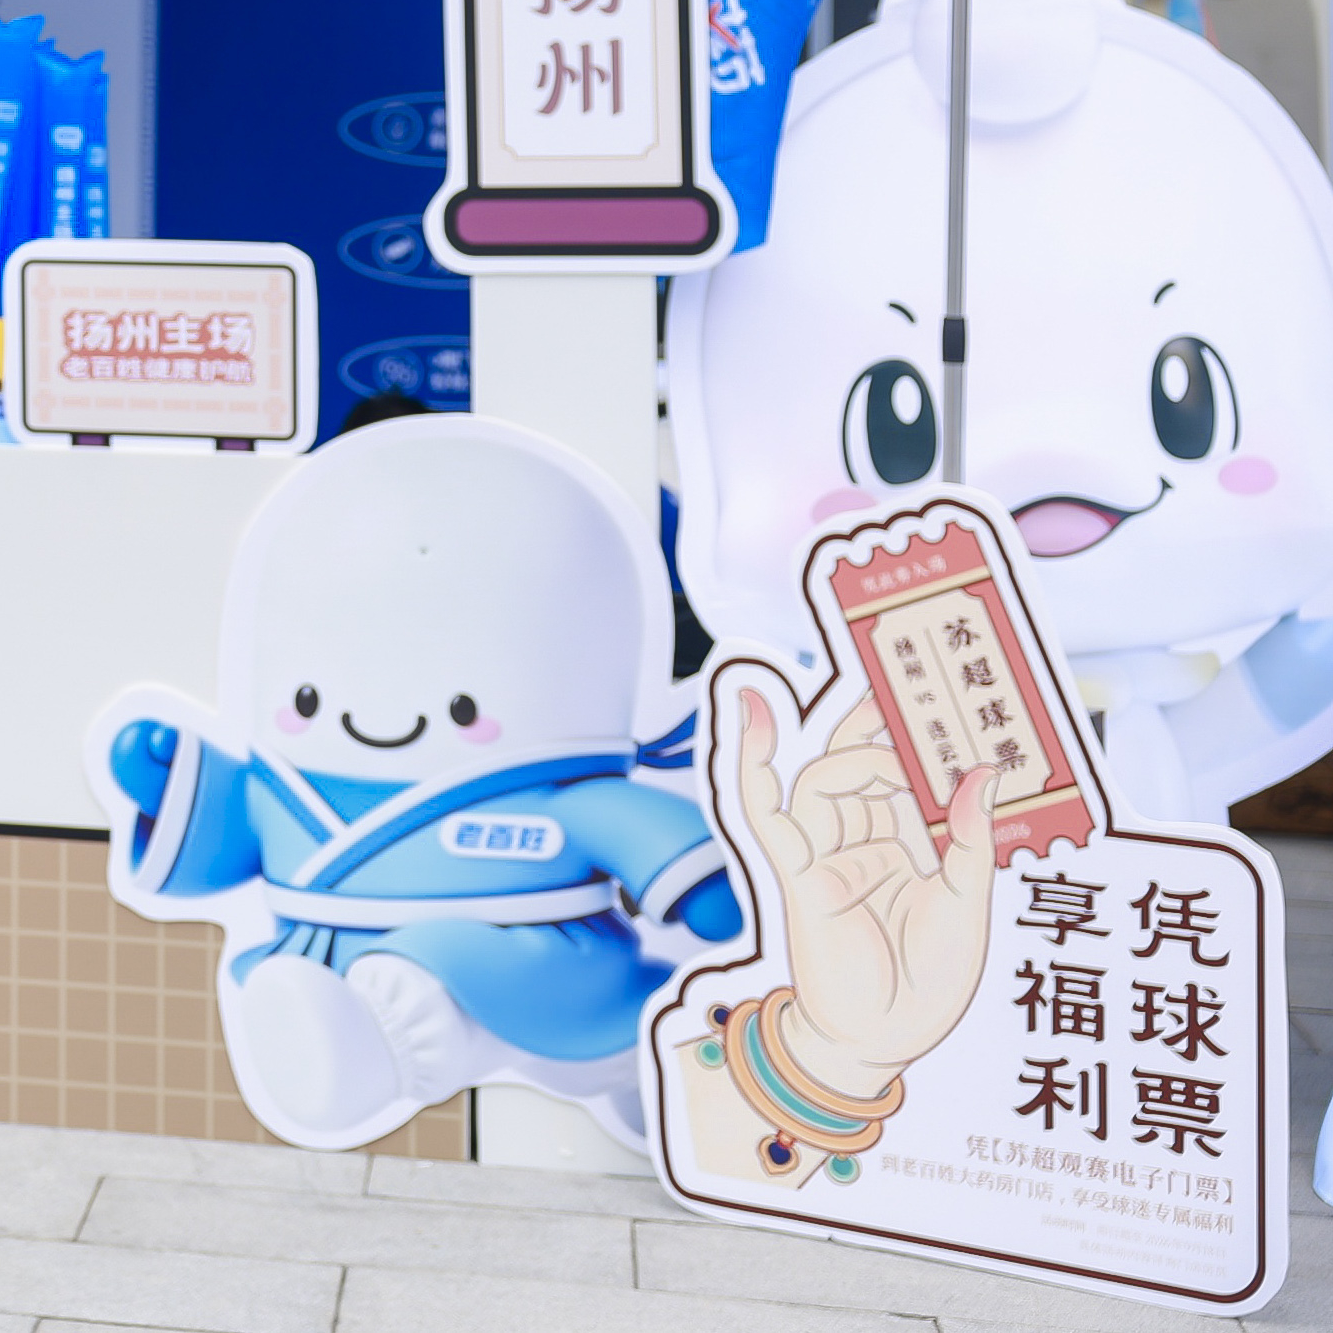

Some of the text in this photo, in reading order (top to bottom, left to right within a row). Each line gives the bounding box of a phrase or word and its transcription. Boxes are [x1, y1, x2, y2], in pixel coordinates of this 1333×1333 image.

[65, 312, 254, 354] 扬州主场
[941, 616, 1029, 773] 苏超球票
[1012, 870, 1113, 1155] 享福利
[1128, 879, 1232, 1159] 凭球票
